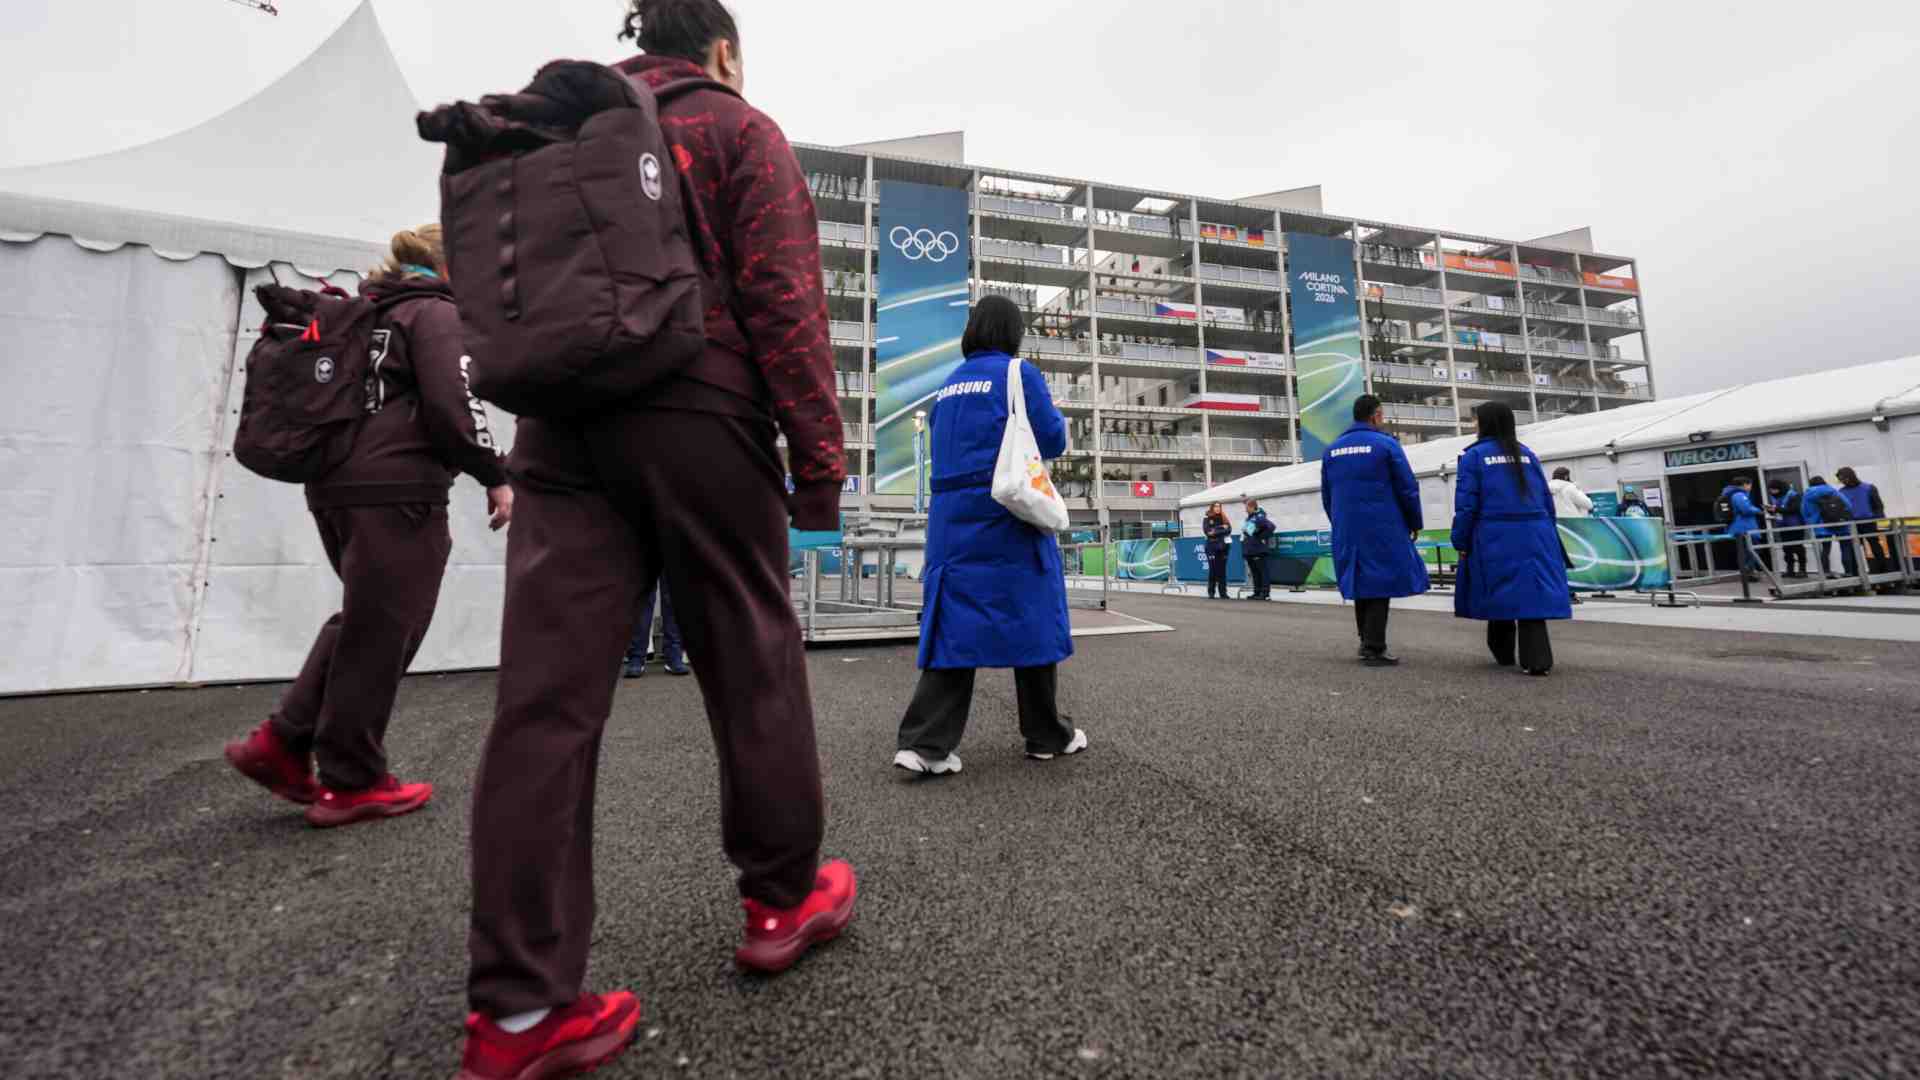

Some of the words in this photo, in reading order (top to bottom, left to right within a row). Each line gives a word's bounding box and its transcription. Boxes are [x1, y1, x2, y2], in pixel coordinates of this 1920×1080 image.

[1298, 271, 1341, 284] MILANO
[1314, 292, 1336, 303] 2026
[936, 380, 993, 401] SAMSUNG
[1330, 445, 1372, 457] SAMSUNG
[1666, 441, 1756, 467] WELCOME
